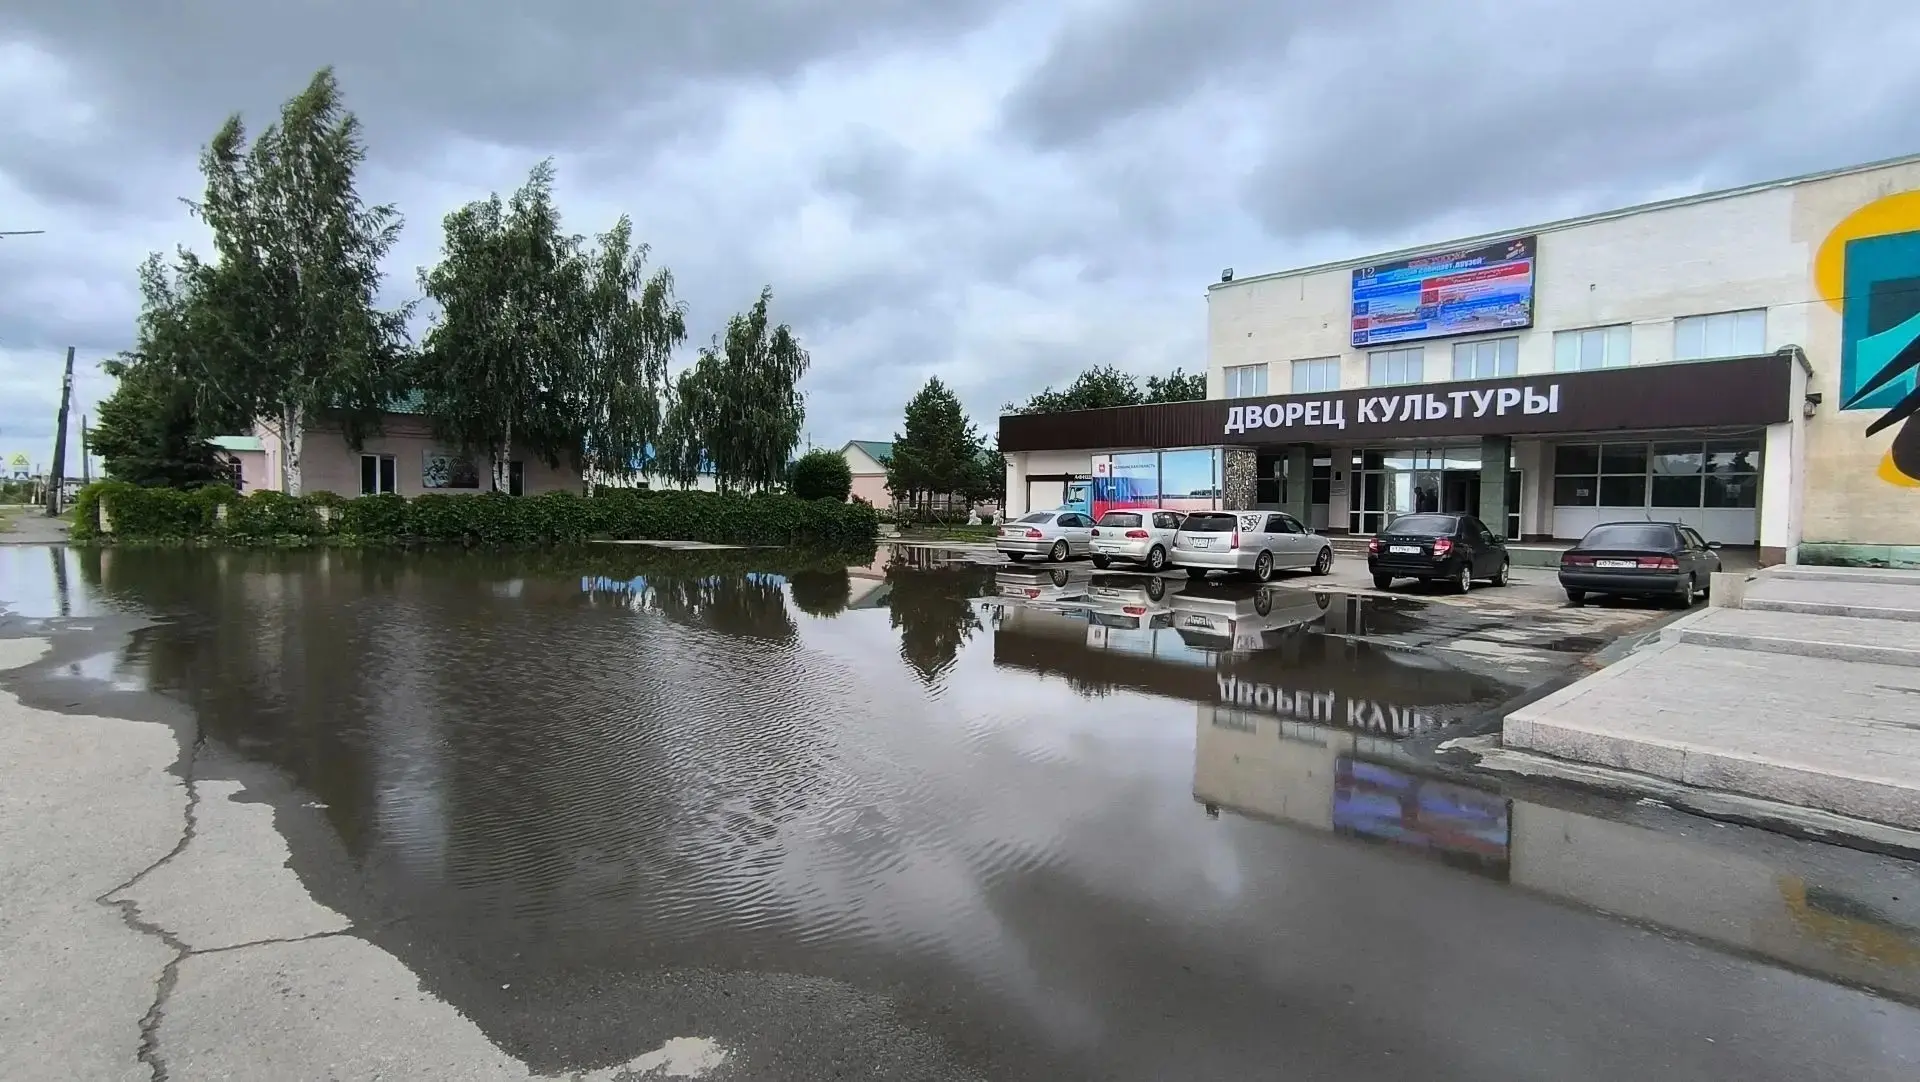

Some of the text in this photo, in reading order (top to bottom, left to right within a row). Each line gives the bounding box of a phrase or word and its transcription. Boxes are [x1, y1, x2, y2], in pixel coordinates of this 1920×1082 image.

[1361, 267, 1375, 280] 12
[1224, 384, 1560, 435] ДВОРЕЦ КУЛЬТУРЫ
